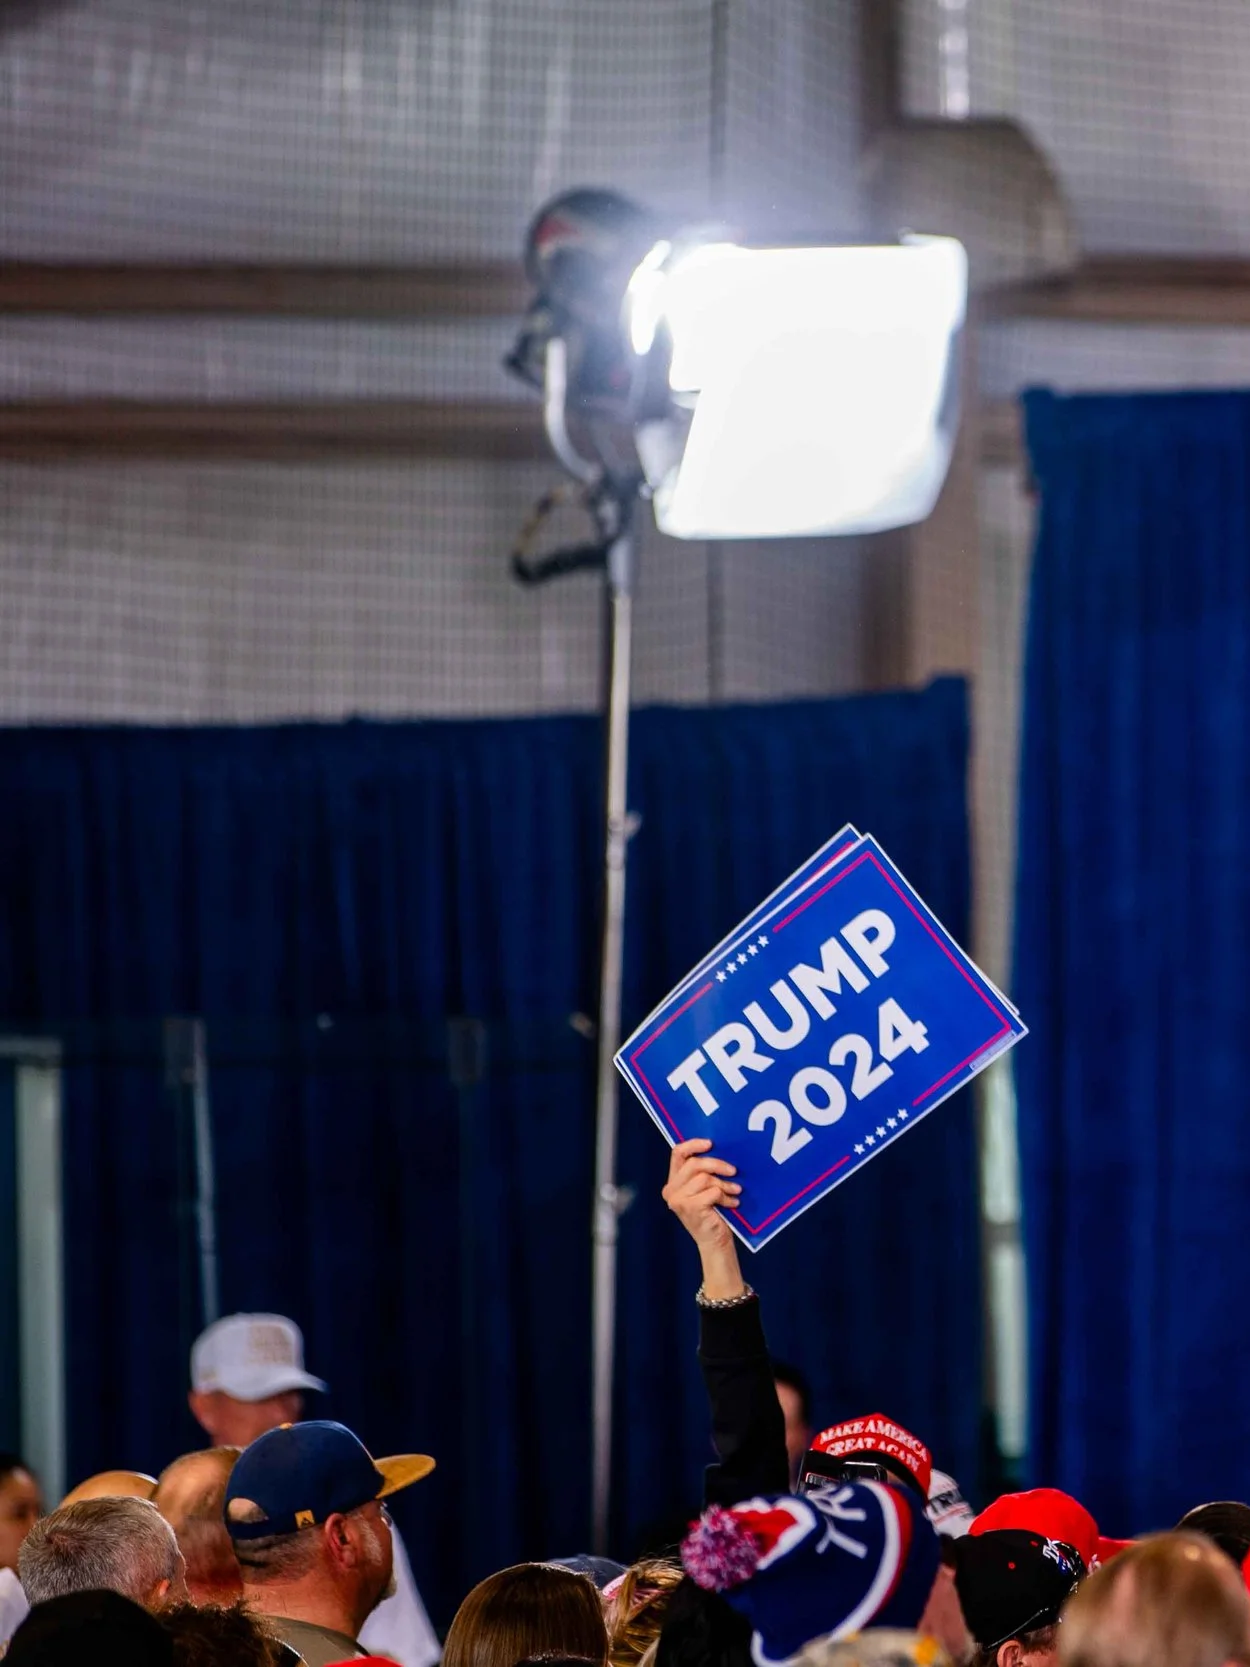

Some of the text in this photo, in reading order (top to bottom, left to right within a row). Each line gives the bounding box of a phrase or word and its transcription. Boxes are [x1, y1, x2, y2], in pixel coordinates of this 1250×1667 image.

[667, 909, 896, 1117] TRUMP
[748, 998, 930, 1165] 2024
[820, 1420, 927, 1462] MAKE AMERICA
[826, 1437, 921, 1472] GREAT AGAIN
